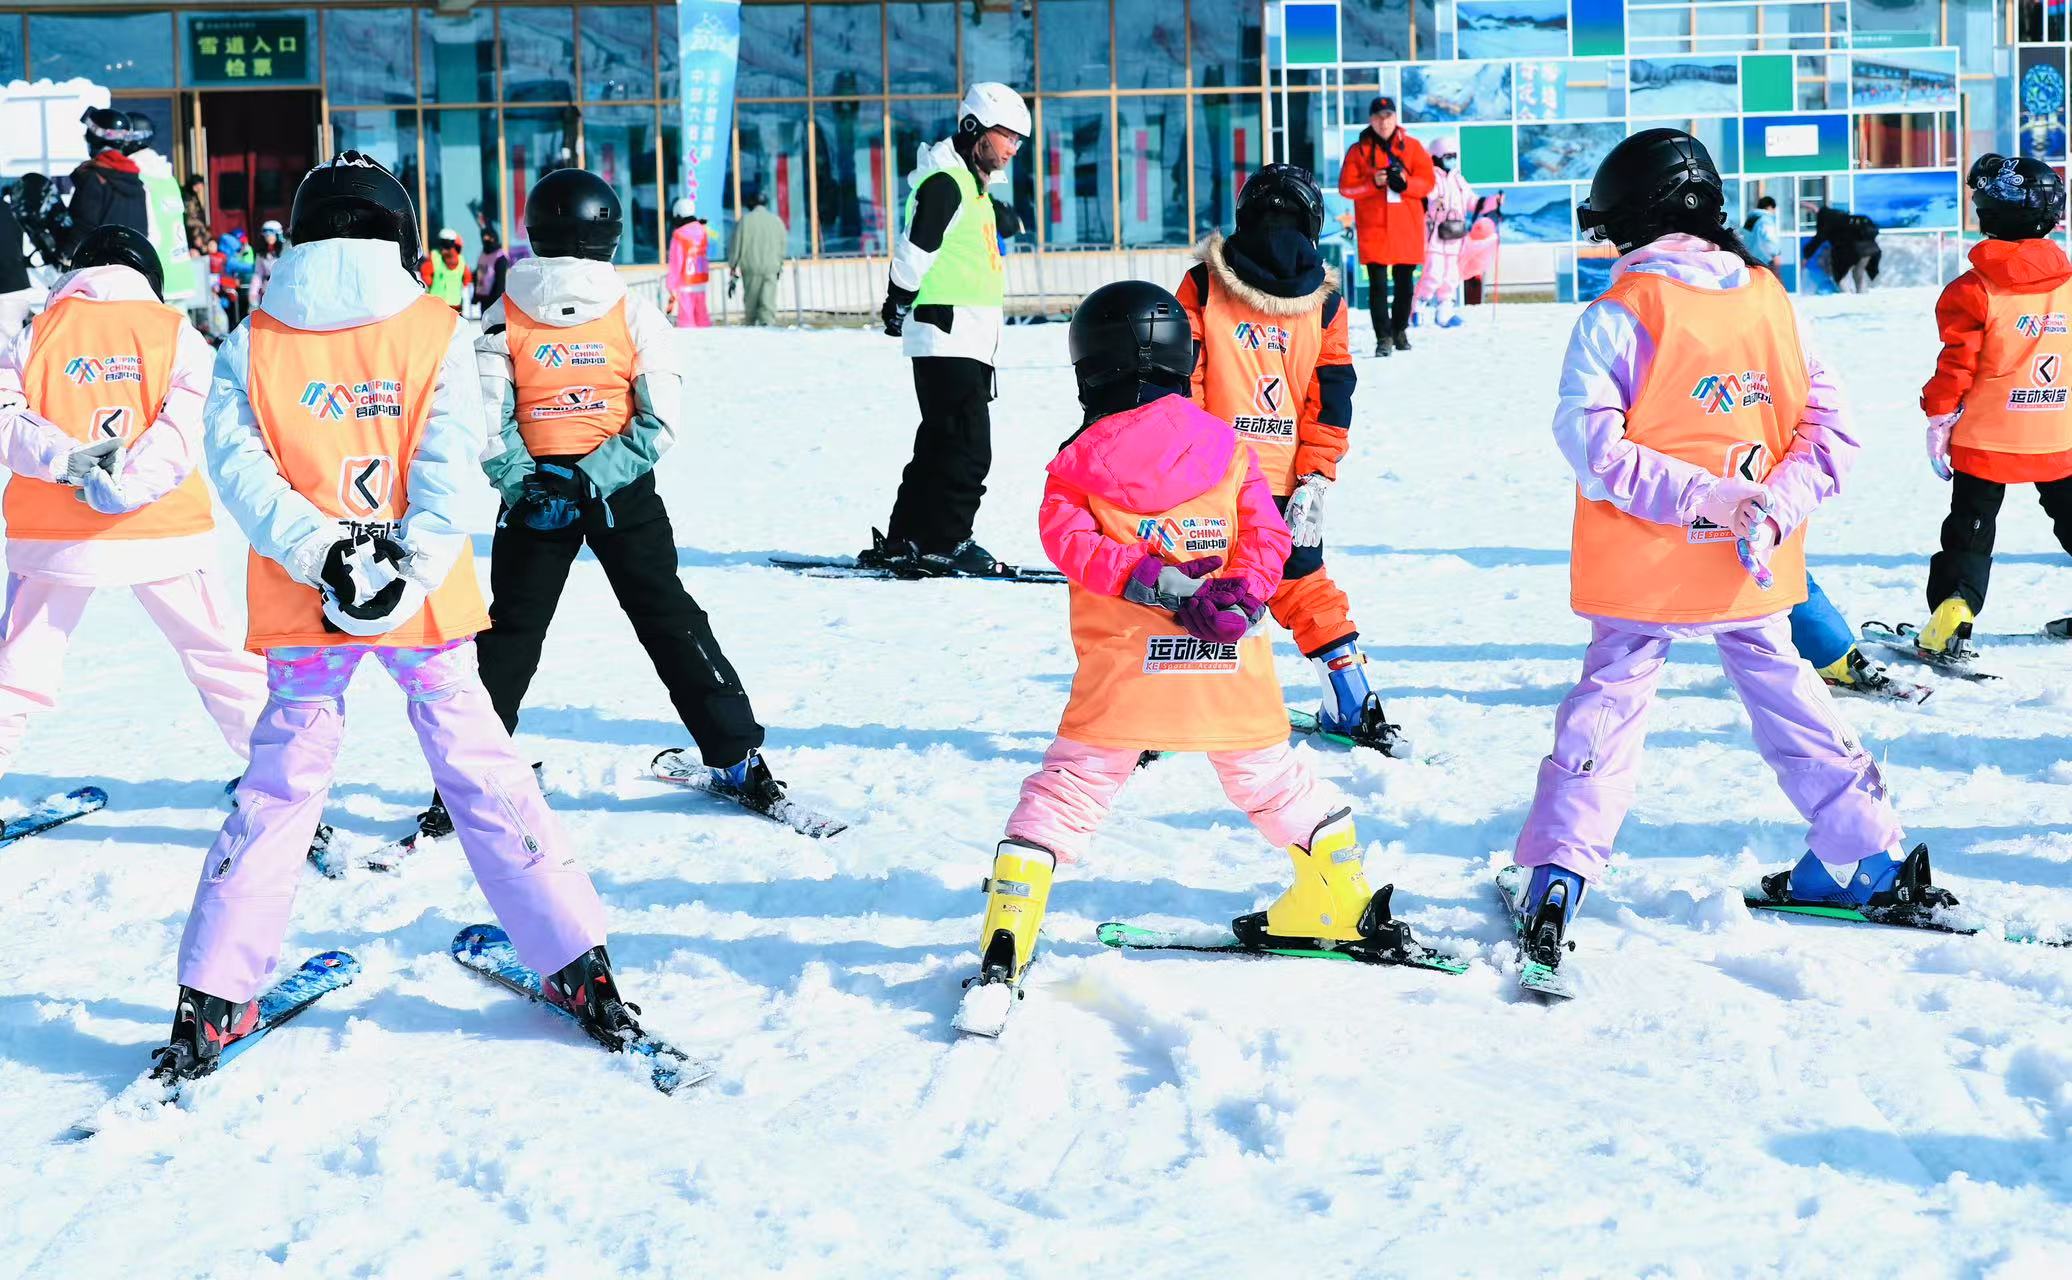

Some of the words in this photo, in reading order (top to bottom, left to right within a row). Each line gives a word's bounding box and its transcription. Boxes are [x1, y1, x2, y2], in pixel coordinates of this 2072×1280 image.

[198, 36, 296, 54] 雪道入口
[225, 58, 272, 77] 检票
[354, 380, 401, 393] CAMPING
[1746, 382, 1768, 393] CHIN
[361, 393, 394, 405] CHINA
[2010, 389, 2066, 403] 运动刻堂
[1233, 417, 1293, 435] 运动刻堂
[1190, 530, 1222, 539] CHINA
[1148, 638, 1238, 660] 运动刻堂
[1147, 662, 1160, 670] KE
[1162, 662, 1191, 671] Sports
[1198, 662, 1233, 670] Academy
